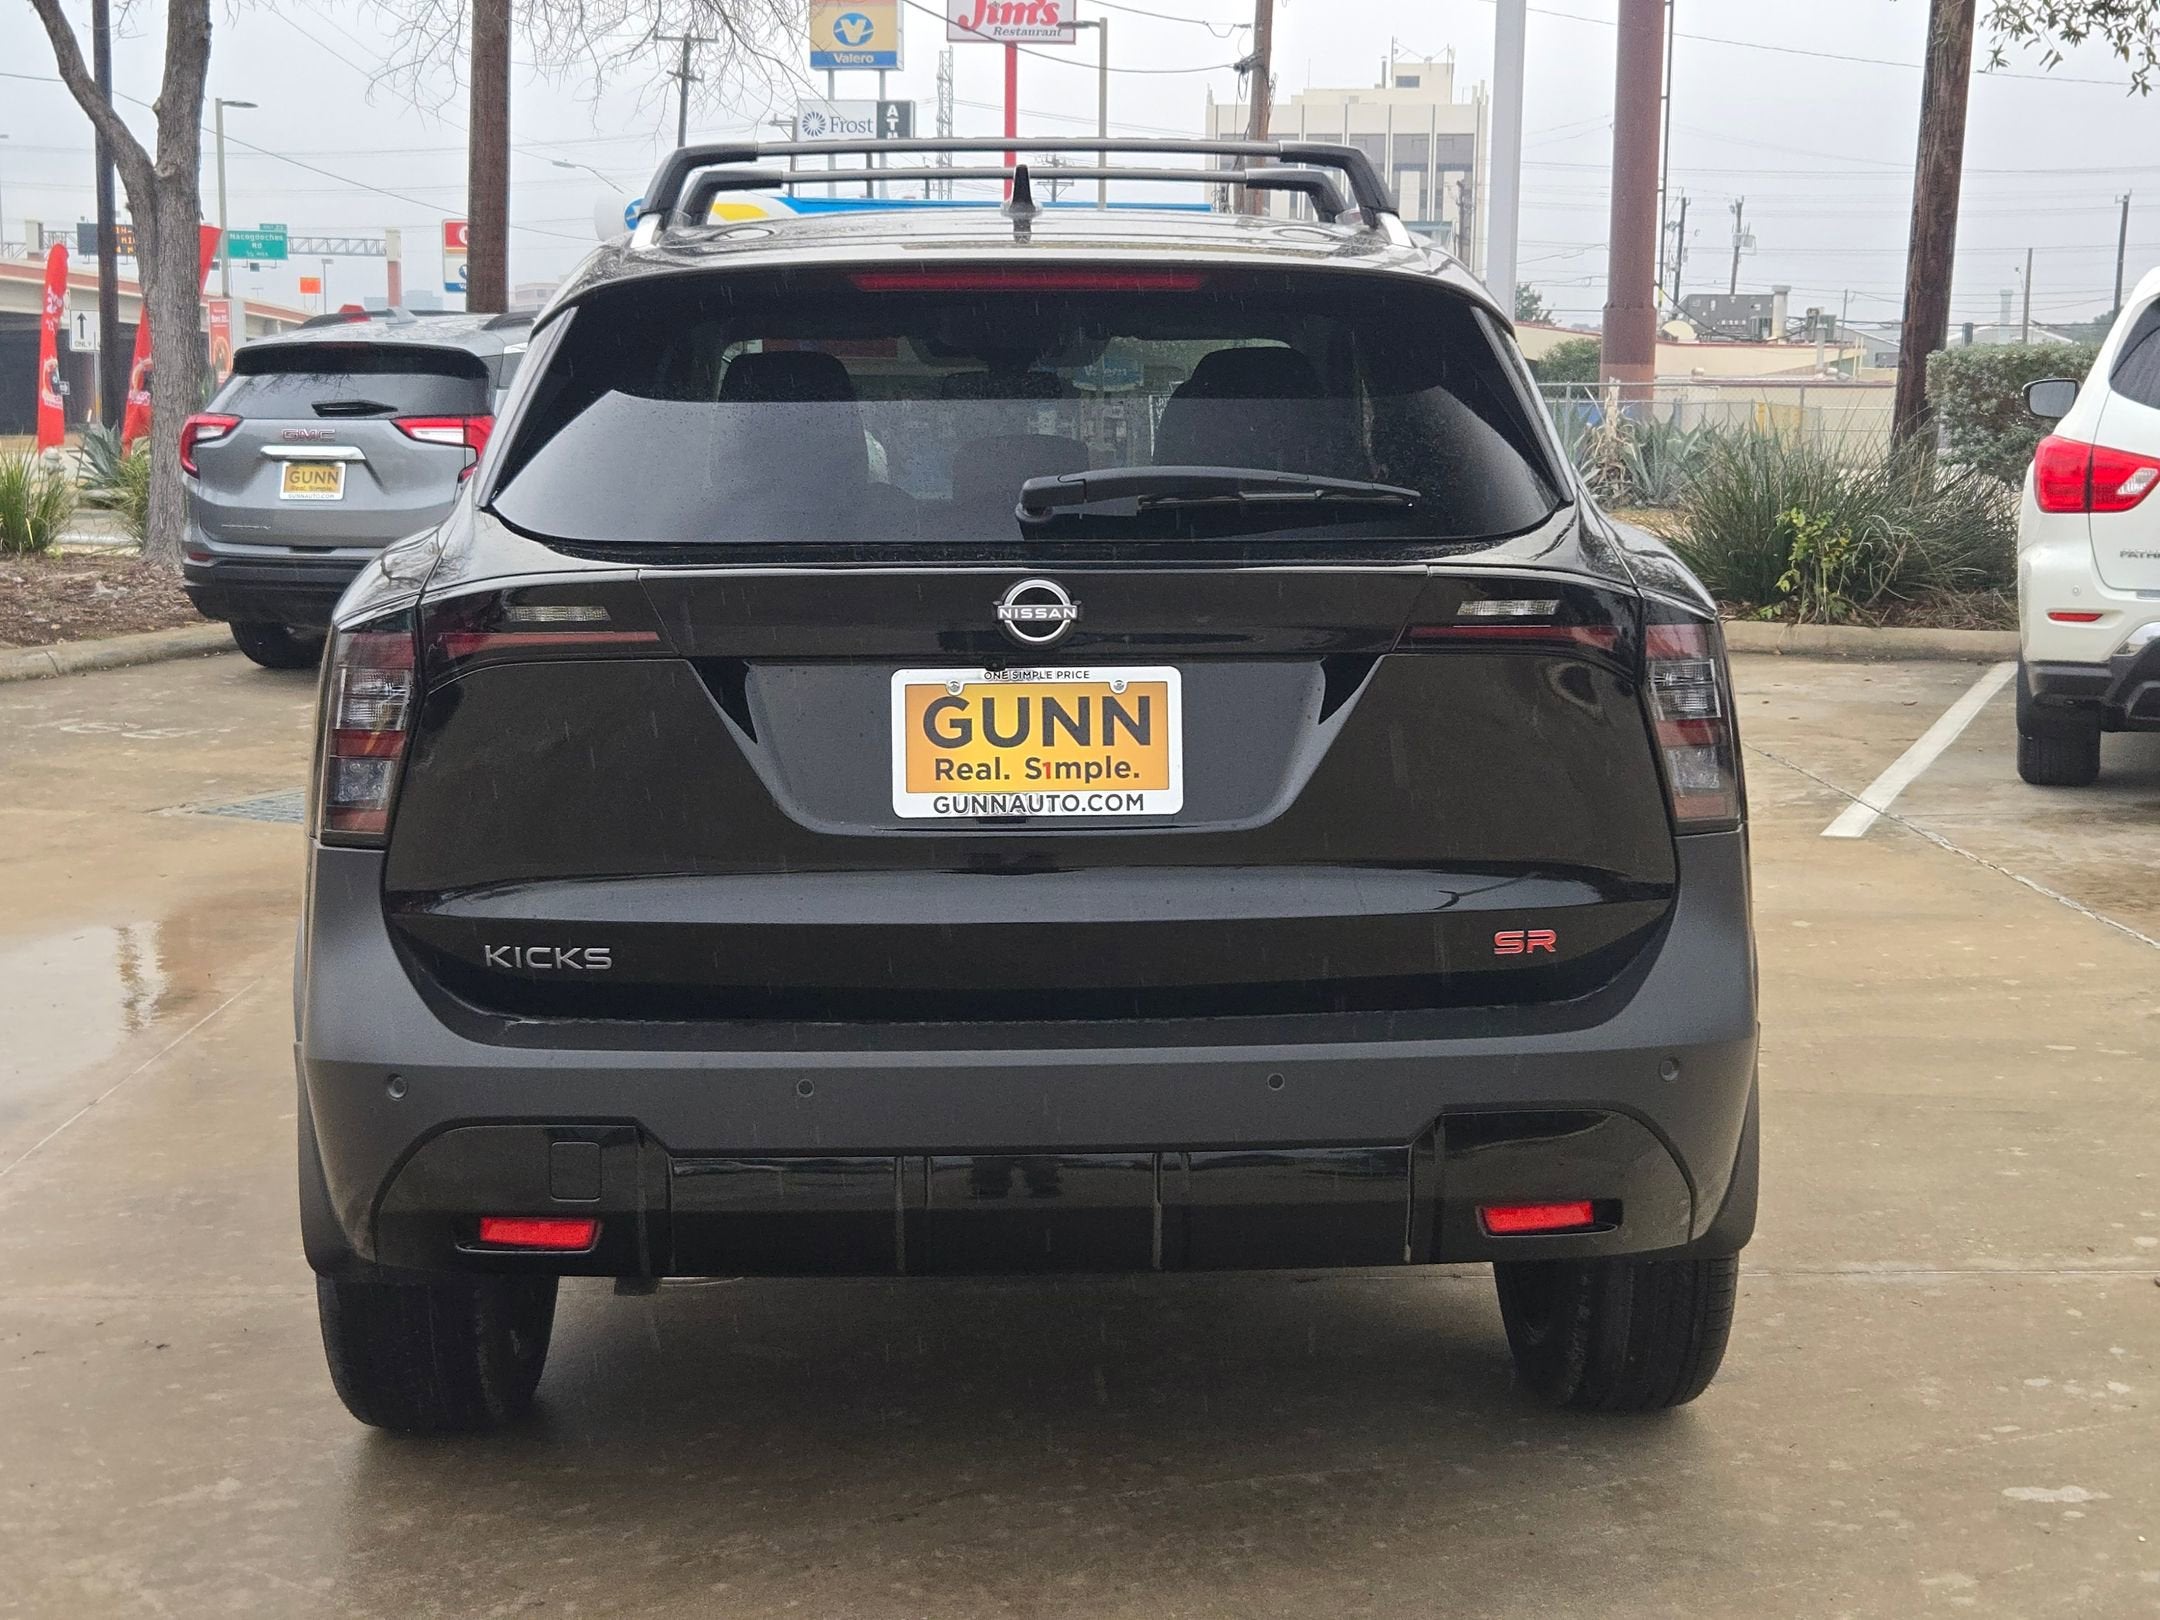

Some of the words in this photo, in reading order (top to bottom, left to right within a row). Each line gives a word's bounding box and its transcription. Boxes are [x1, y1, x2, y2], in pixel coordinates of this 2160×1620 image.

[957, 0, 1060, 32] Jim's
[992, 26, 1062, 37] Restaurant
[833, 52, 875, 64] Valero
[829, 116, 874, 134] Frost
[229, 233, 284, 241] Nacogdoches
[281, 428, 336, 441] GMC
[289, 470, 339, 484] GUNN
[999, 607, 1077, 619] NISSAN
[984, 671, 1008, 681] ONE
[1012, 670, 1053, 680] SIMPLE
[1056, 670, 1090, 679] PRICE
[922, 695, 1151, 749] GUNN
[934, 757, 1010, 781] Real.
[933, 793, 1145, 814] GUNNAUTO.COM
[1493, 929, 1557, 955] SR
[484, 944, 613, 970] KICKS
